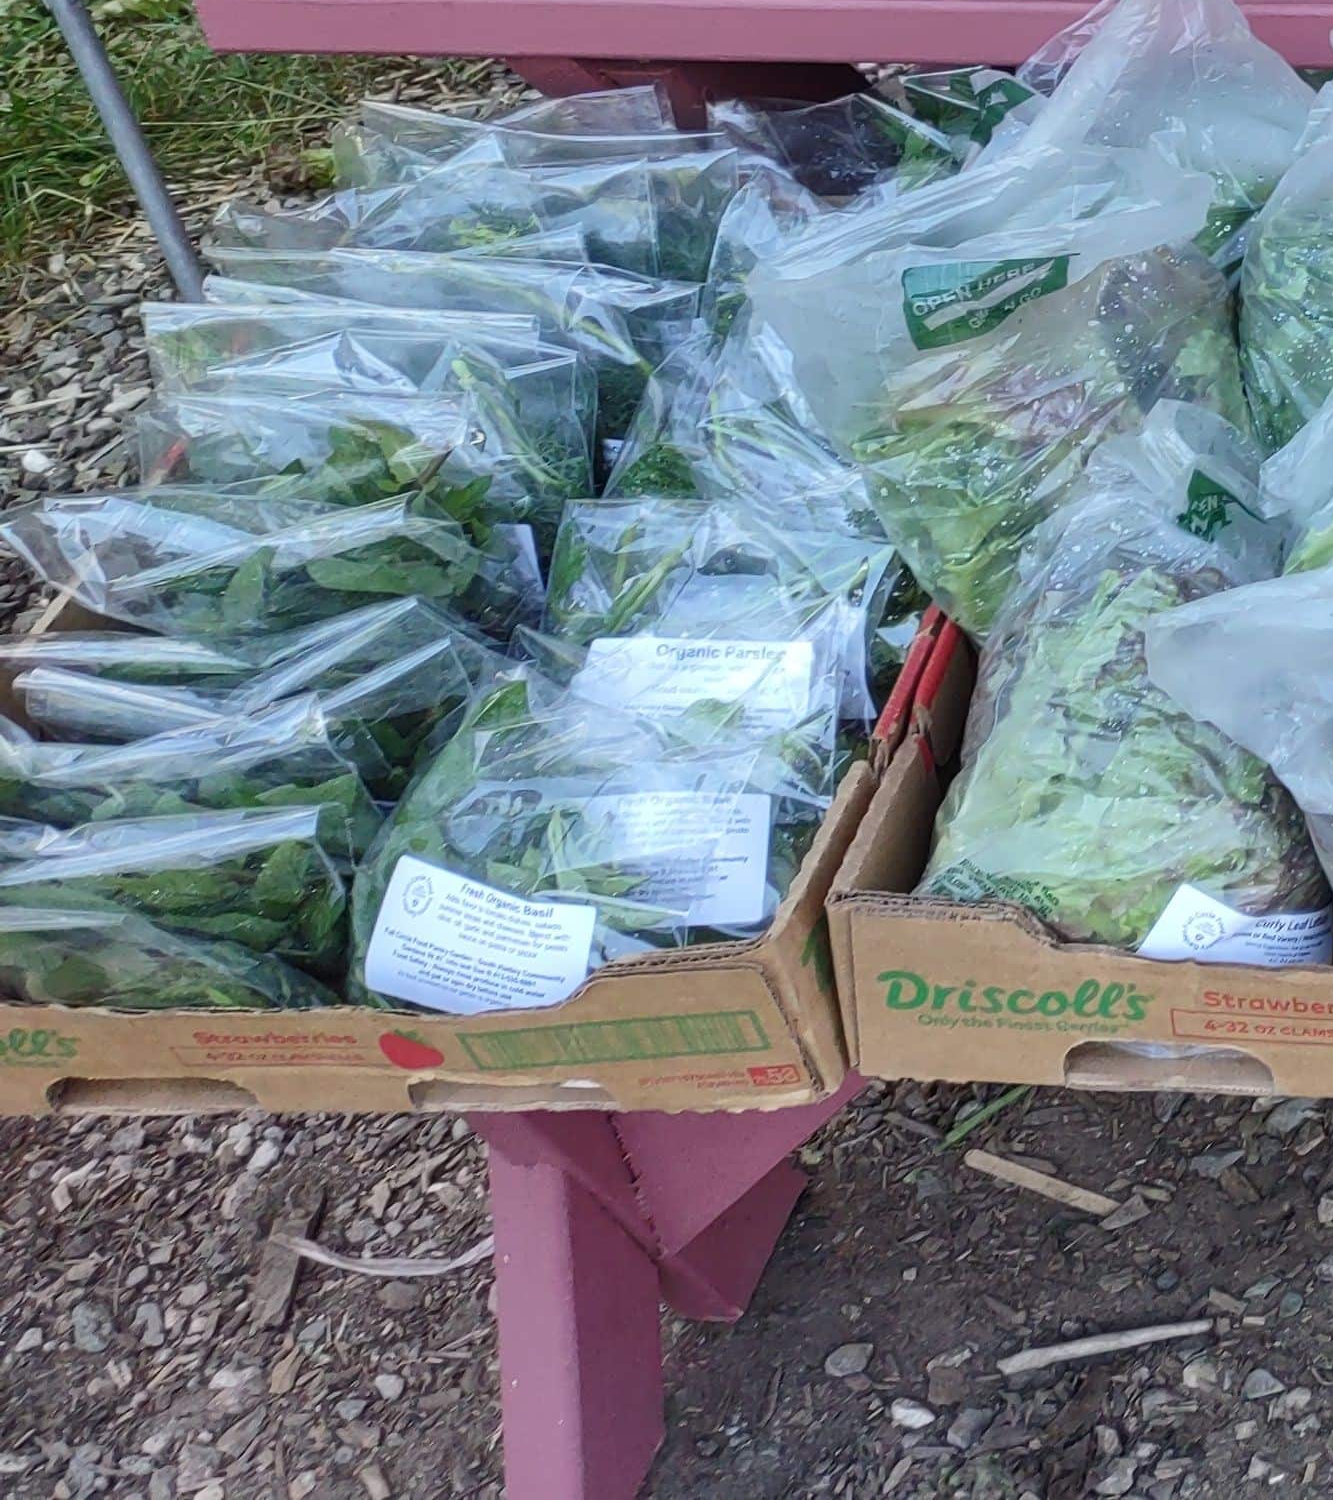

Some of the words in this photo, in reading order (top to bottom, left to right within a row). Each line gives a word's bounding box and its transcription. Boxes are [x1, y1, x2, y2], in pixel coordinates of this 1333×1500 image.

[912, 284, 973, 317] OPEN
[977, 262, 1036, 292] HERE
[656, 643, 721, 661] Organic
[460, 883, 486, 900] Fresh
[486, 887, 522, 915] Organic
[523, 903, 555, 919] Basil
[875, 968, 1157, 1022] Driscoll's
[917, 1012, 959, 1030] Only
[961, 1013, 992, 1028] the
